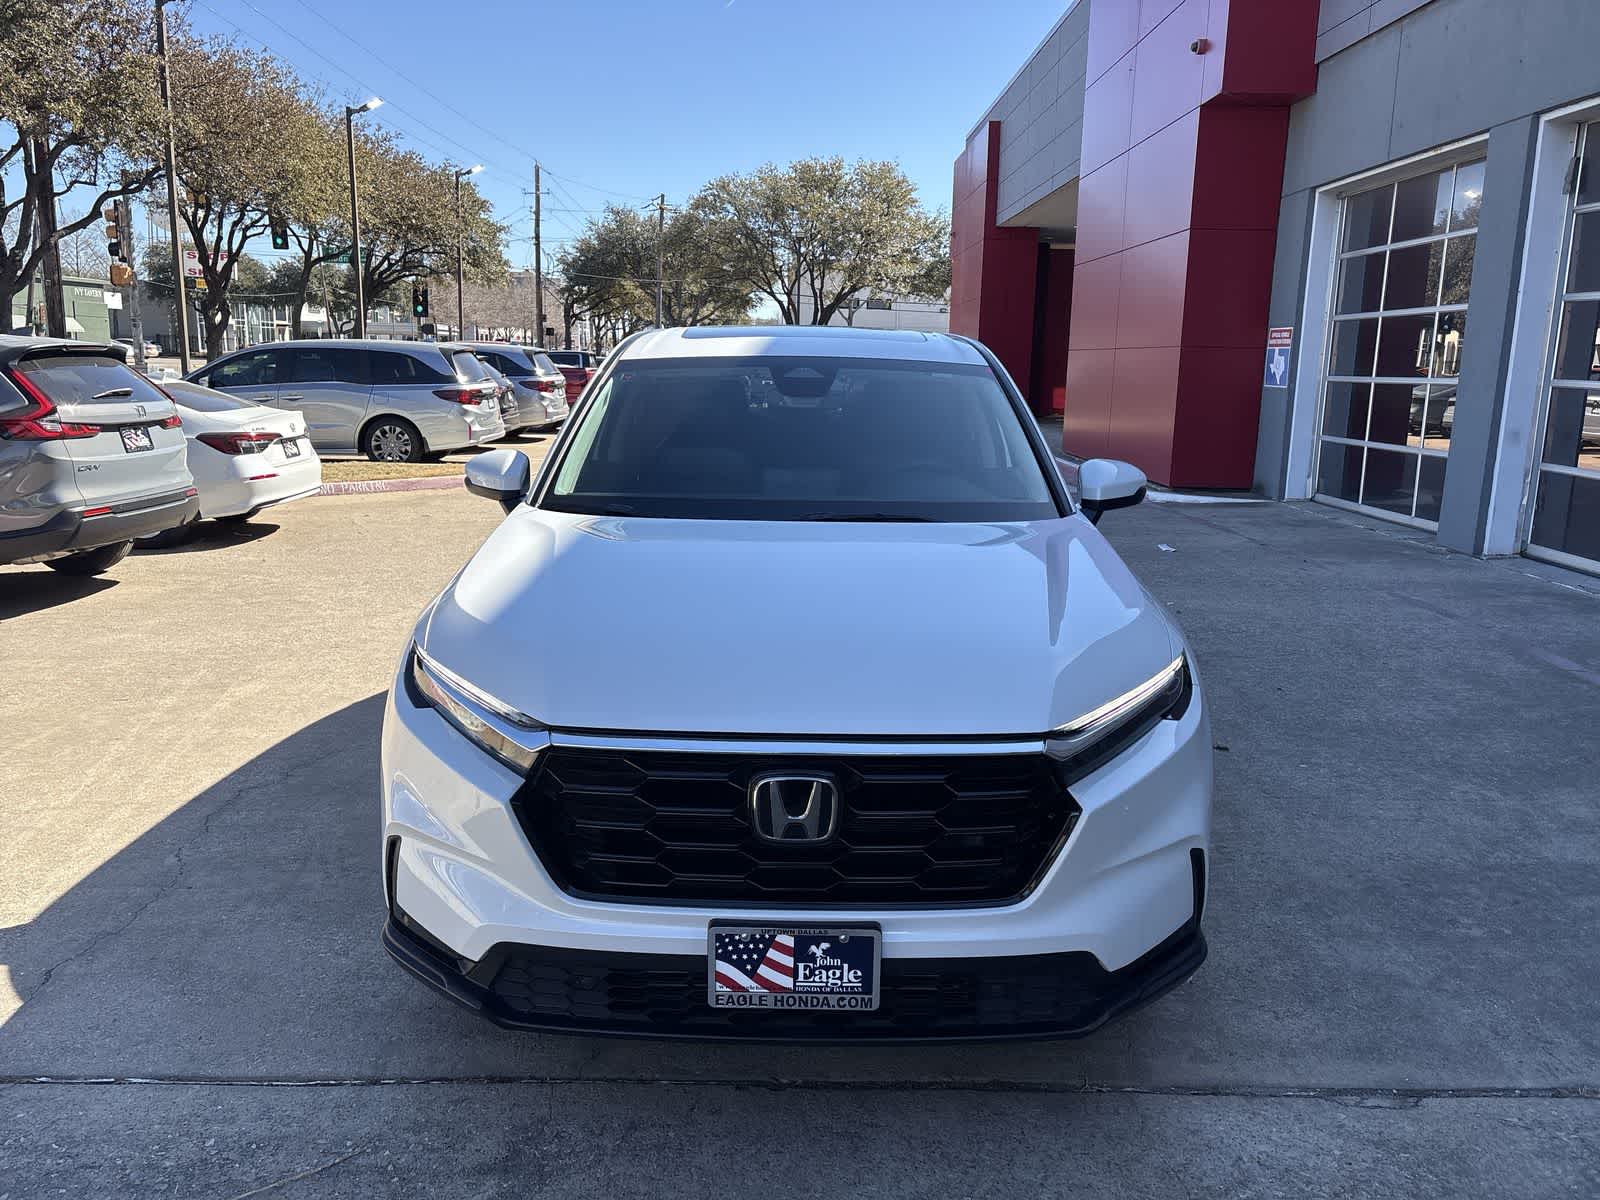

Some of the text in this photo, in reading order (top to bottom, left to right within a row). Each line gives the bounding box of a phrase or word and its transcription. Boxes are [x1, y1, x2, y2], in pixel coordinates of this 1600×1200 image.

[761, 928, 795, 936] UPTOWN
[814, 956, 841, 968] John
[795, 962, 863, 987] Eagle
[715, 994, 873, 1009] EAGLE HONDA.COM
